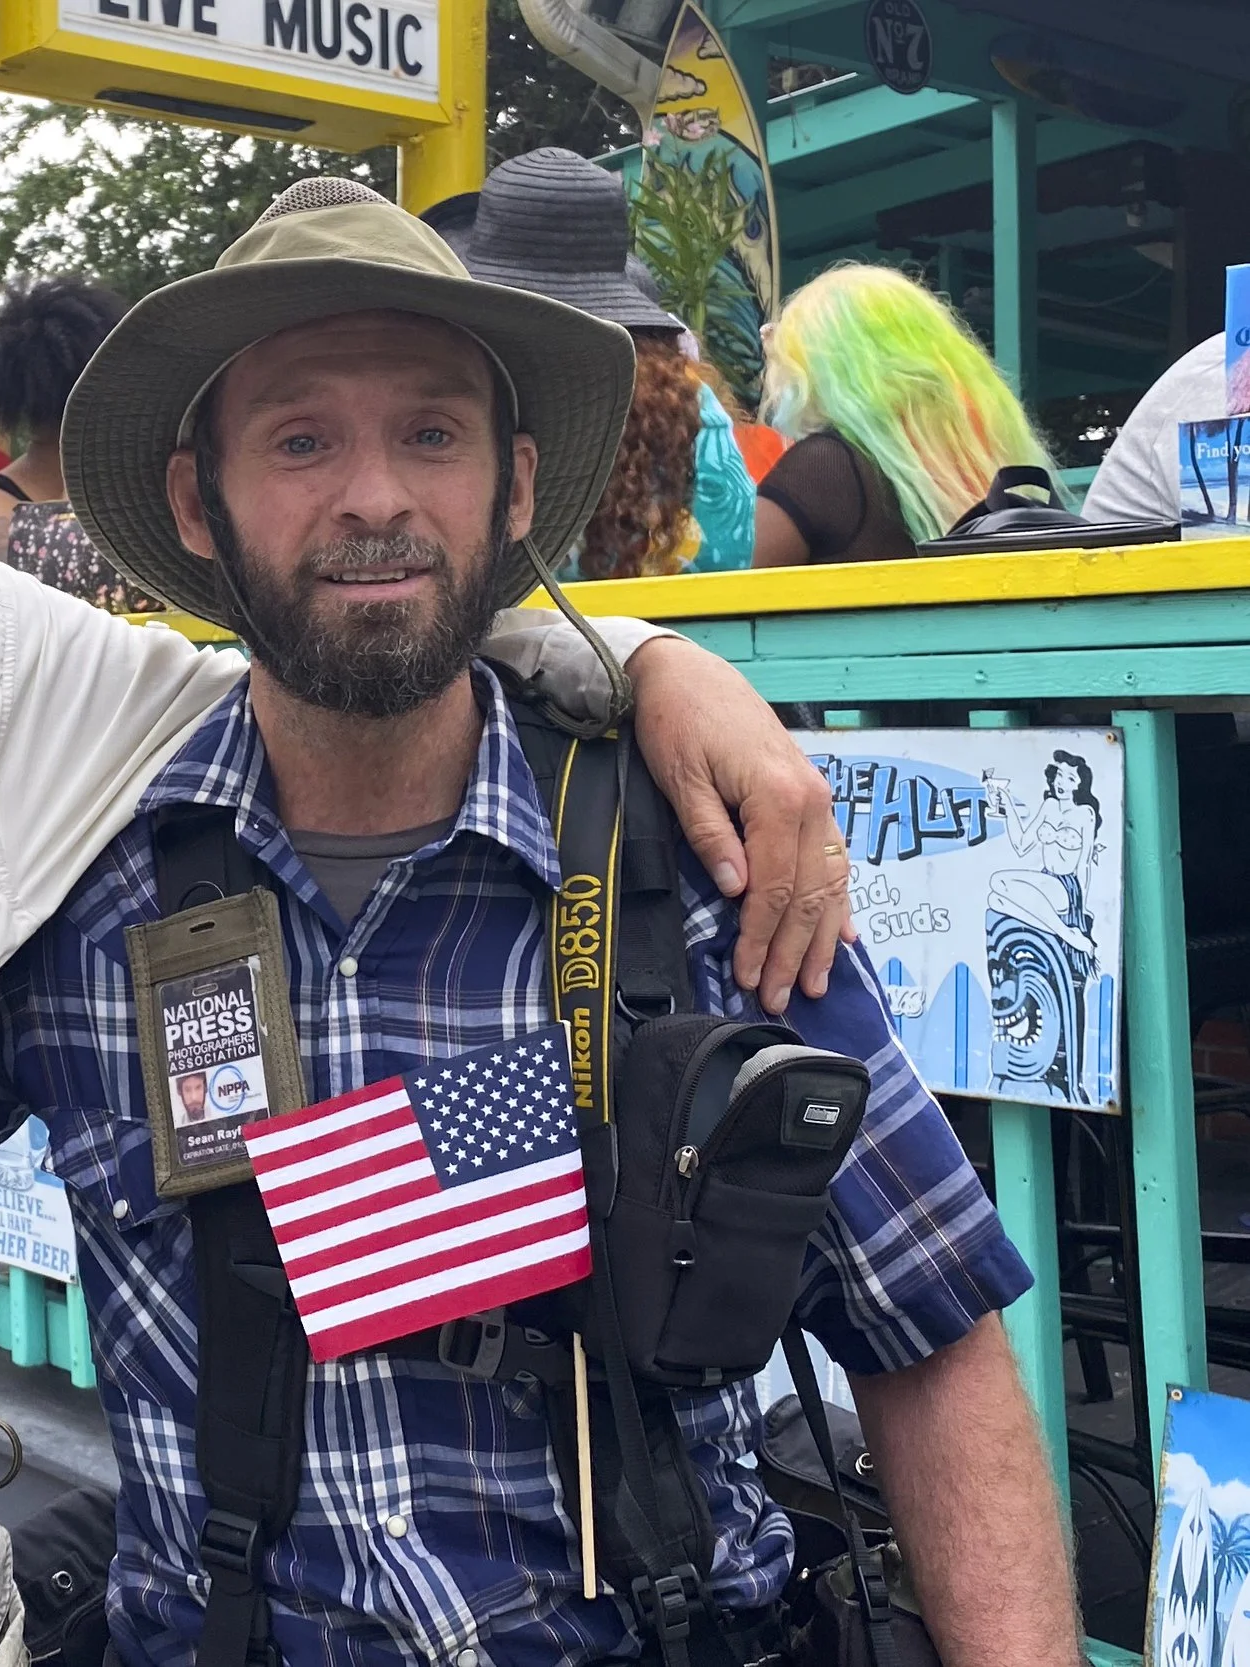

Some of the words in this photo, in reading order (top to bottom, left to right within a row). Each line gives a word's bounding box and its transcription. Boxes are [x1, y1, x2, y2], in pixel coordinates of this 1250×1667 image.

[885, 2, 910, 17] OLD
[264, 0, 423, 77] MUSIC
[1197, 441, 1229, 459] Find
[867, 766, 989, 866] HUT
[559, 874, 602, 994] D850
[869, 903, 950, 944] Suds
[163, 988, 251, 1026] NATIONAL
[165, 1006, 253, 1051] PRESS
[167, 1031, 255, 1062] PHOTOGRAPHERS
[169, 1043, 256, 1073] ASSOCIATION
[572, 1007, 594, 1108] Nikon
[217, 1079, 251, 1098] NPPA
[187, 1133, 215, 1147] Sean
[31, 1239, 70, 1274] BEER
